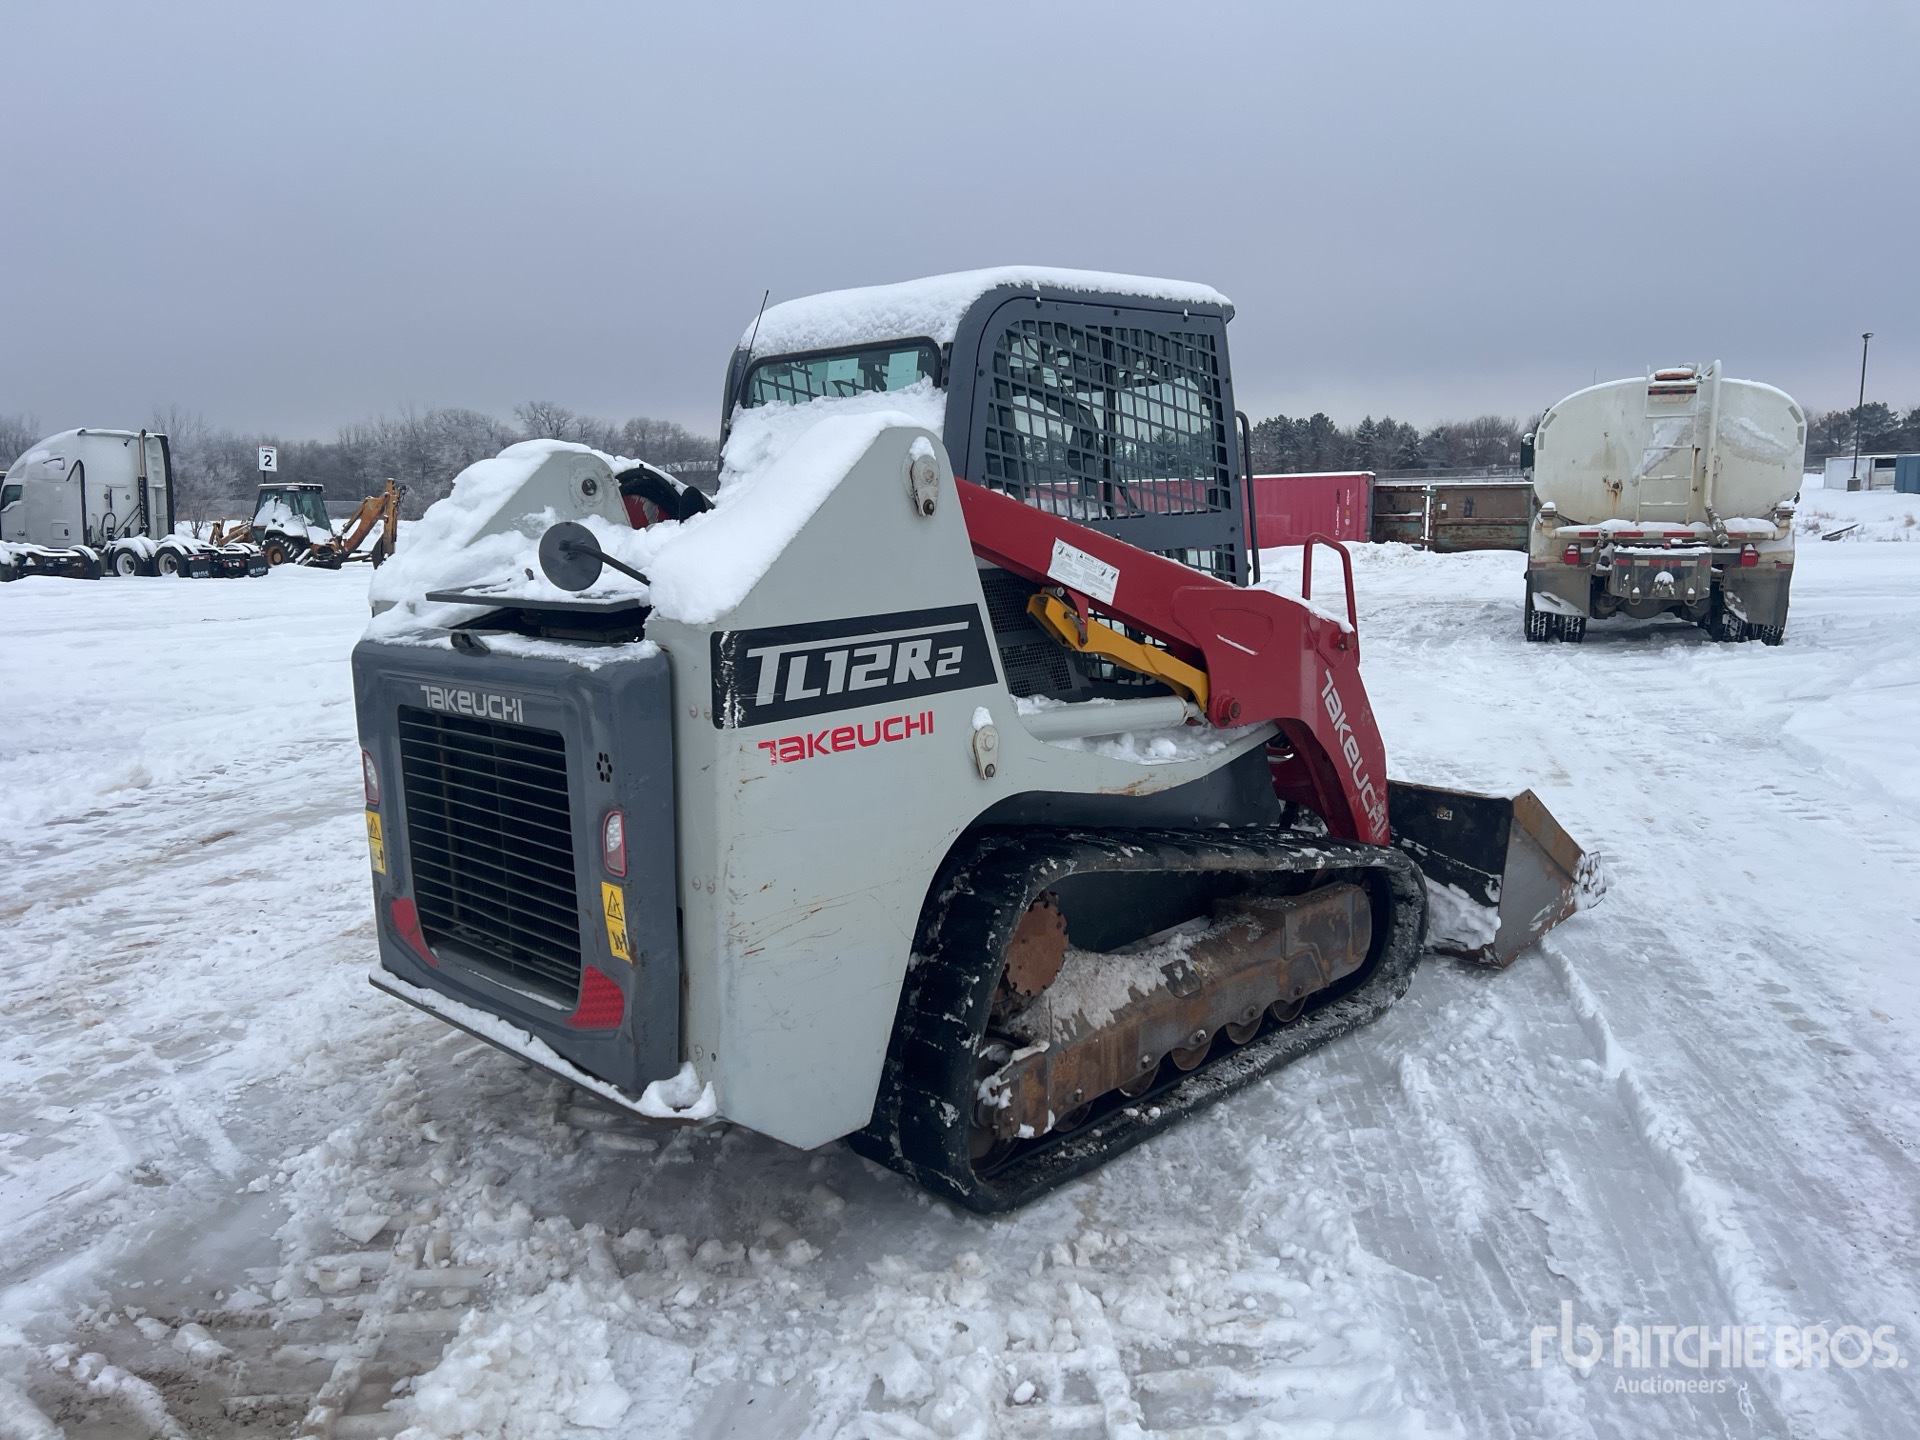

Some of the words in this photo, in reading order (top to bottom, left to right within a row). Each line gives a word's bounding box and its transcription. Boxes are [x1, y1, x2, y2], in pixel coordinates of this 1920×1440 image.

[264, 454, 272, 467] 2
[747, 621, 970, 706] TL12R2
[421, 685, 523, 723] TAKEUCHI
[758, 711, 934, 766] TAKEUCHI
[1321, 668, 1387, 838] TAKEUCHI
